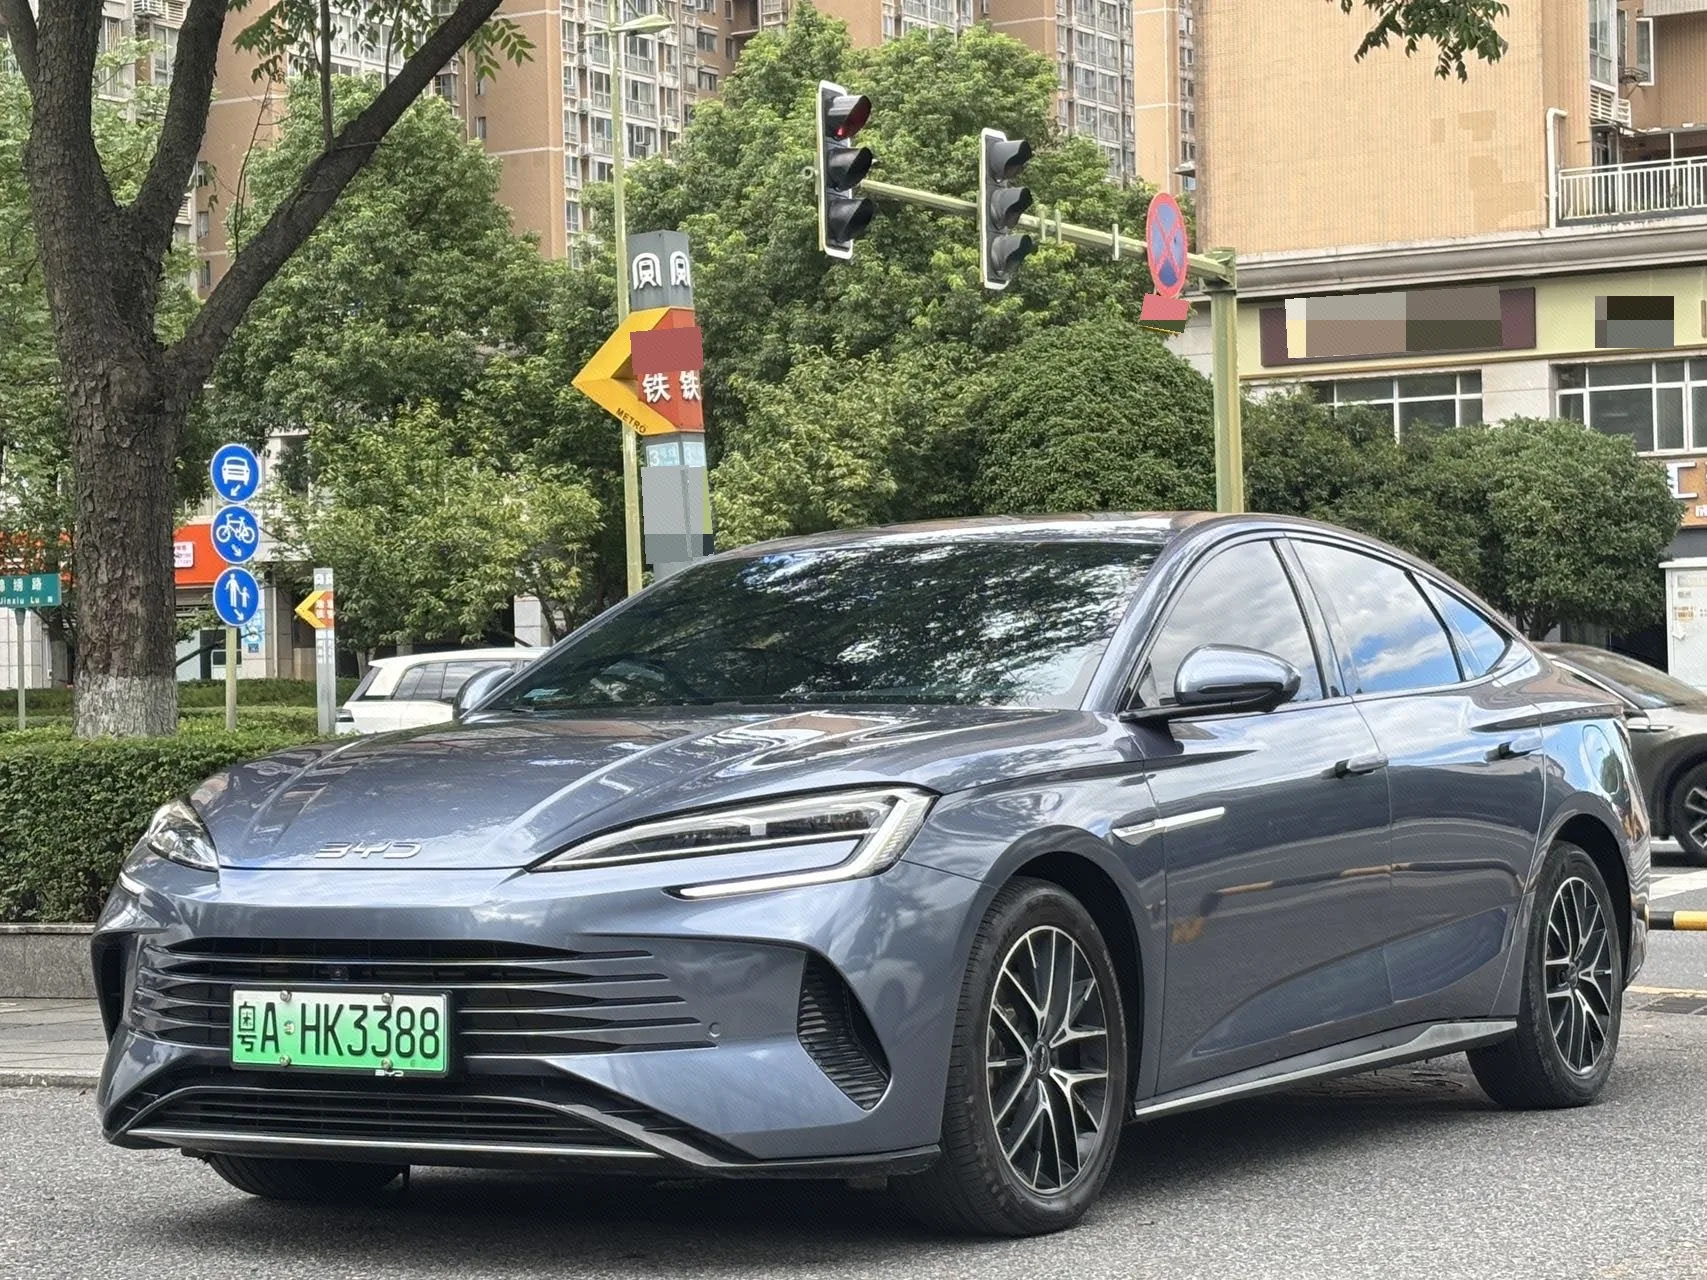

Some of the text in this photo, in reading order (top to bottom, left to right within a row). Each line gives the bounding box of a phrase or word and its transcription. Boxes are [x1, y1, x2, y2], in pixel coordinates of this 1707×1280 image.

[641, 373, 671, 402] 铁
[616, 408, 647, 434] METRO
[314, 841, 422, 859] BYD
[375, 1069, 404, 1077] BYD
